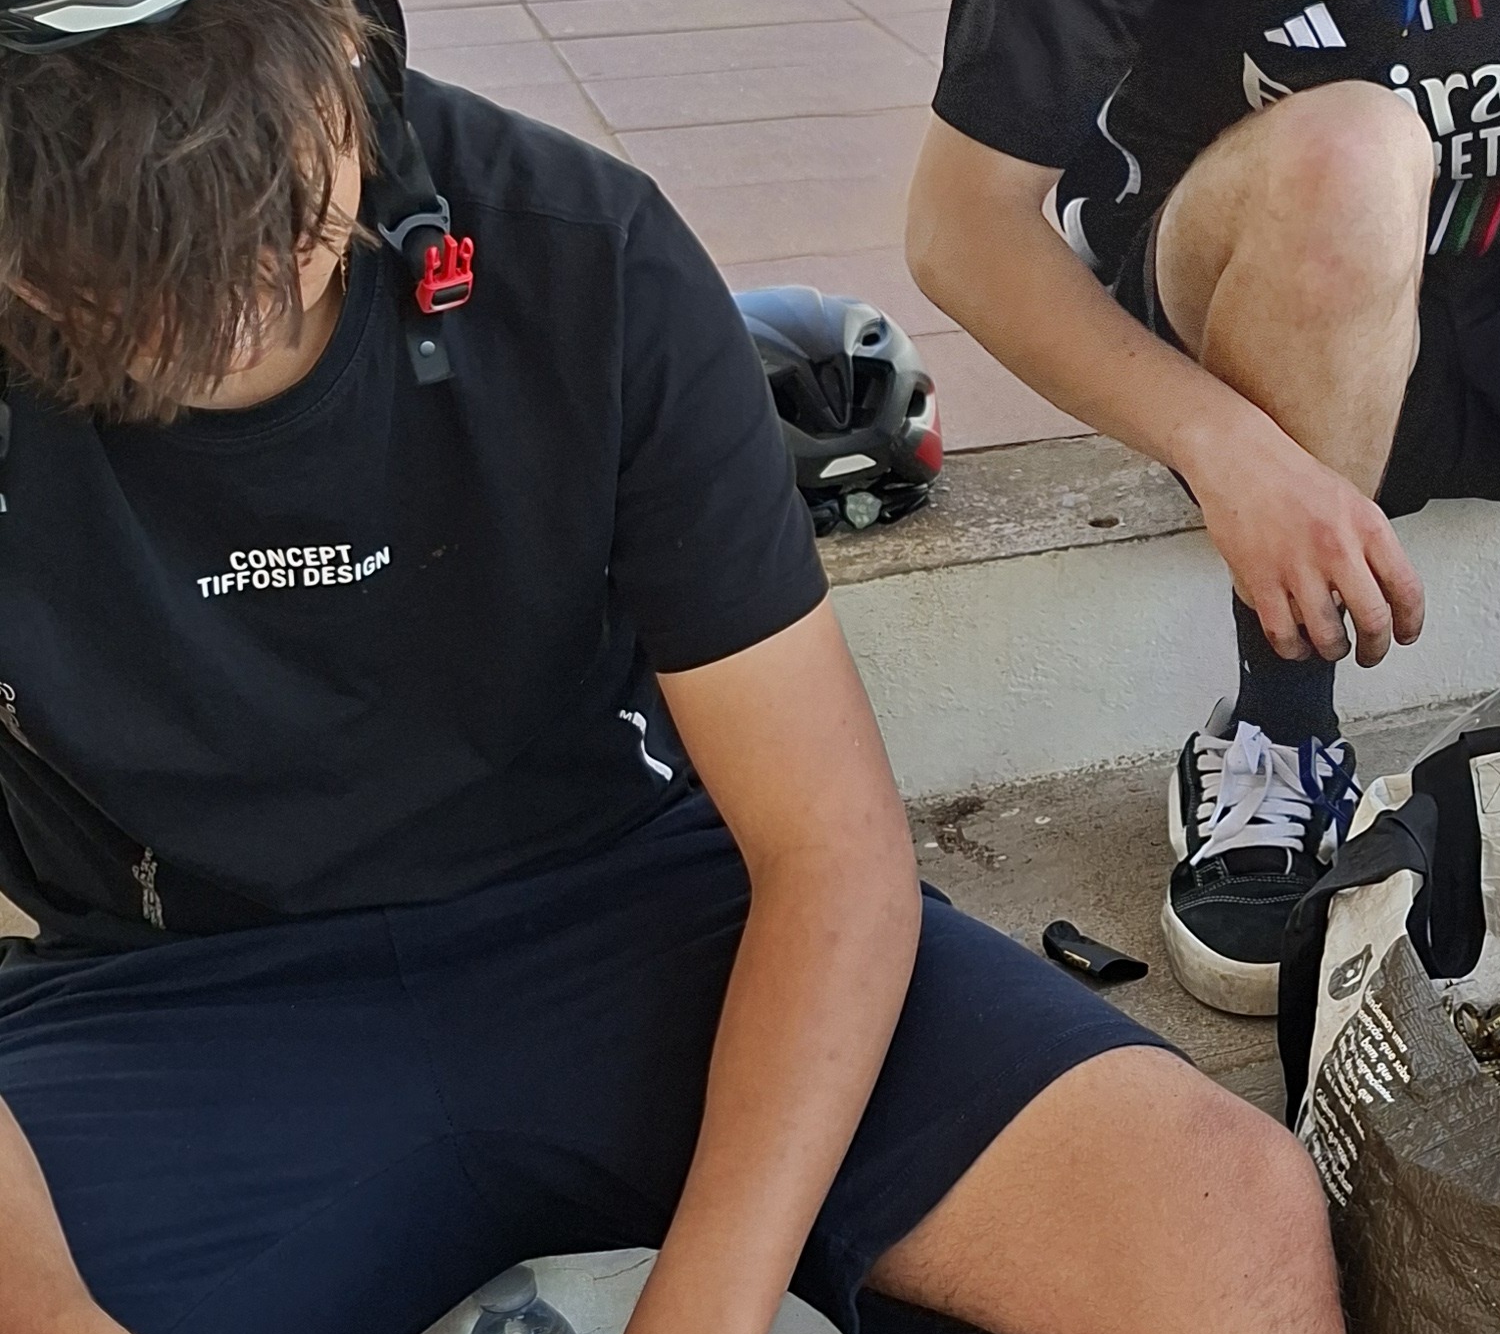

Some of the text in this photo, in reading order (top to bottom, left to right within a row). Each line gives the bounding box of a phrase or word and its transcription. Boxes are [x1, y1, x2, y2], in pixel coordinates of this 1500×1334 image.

[229, 544, 352, 571] CONCEPT
[197, 546, 391, 598] TIFFOSI DESIGN
[1378, 1038, 1398, 1062] que
[1375, 1060, 1394, 1083] que
